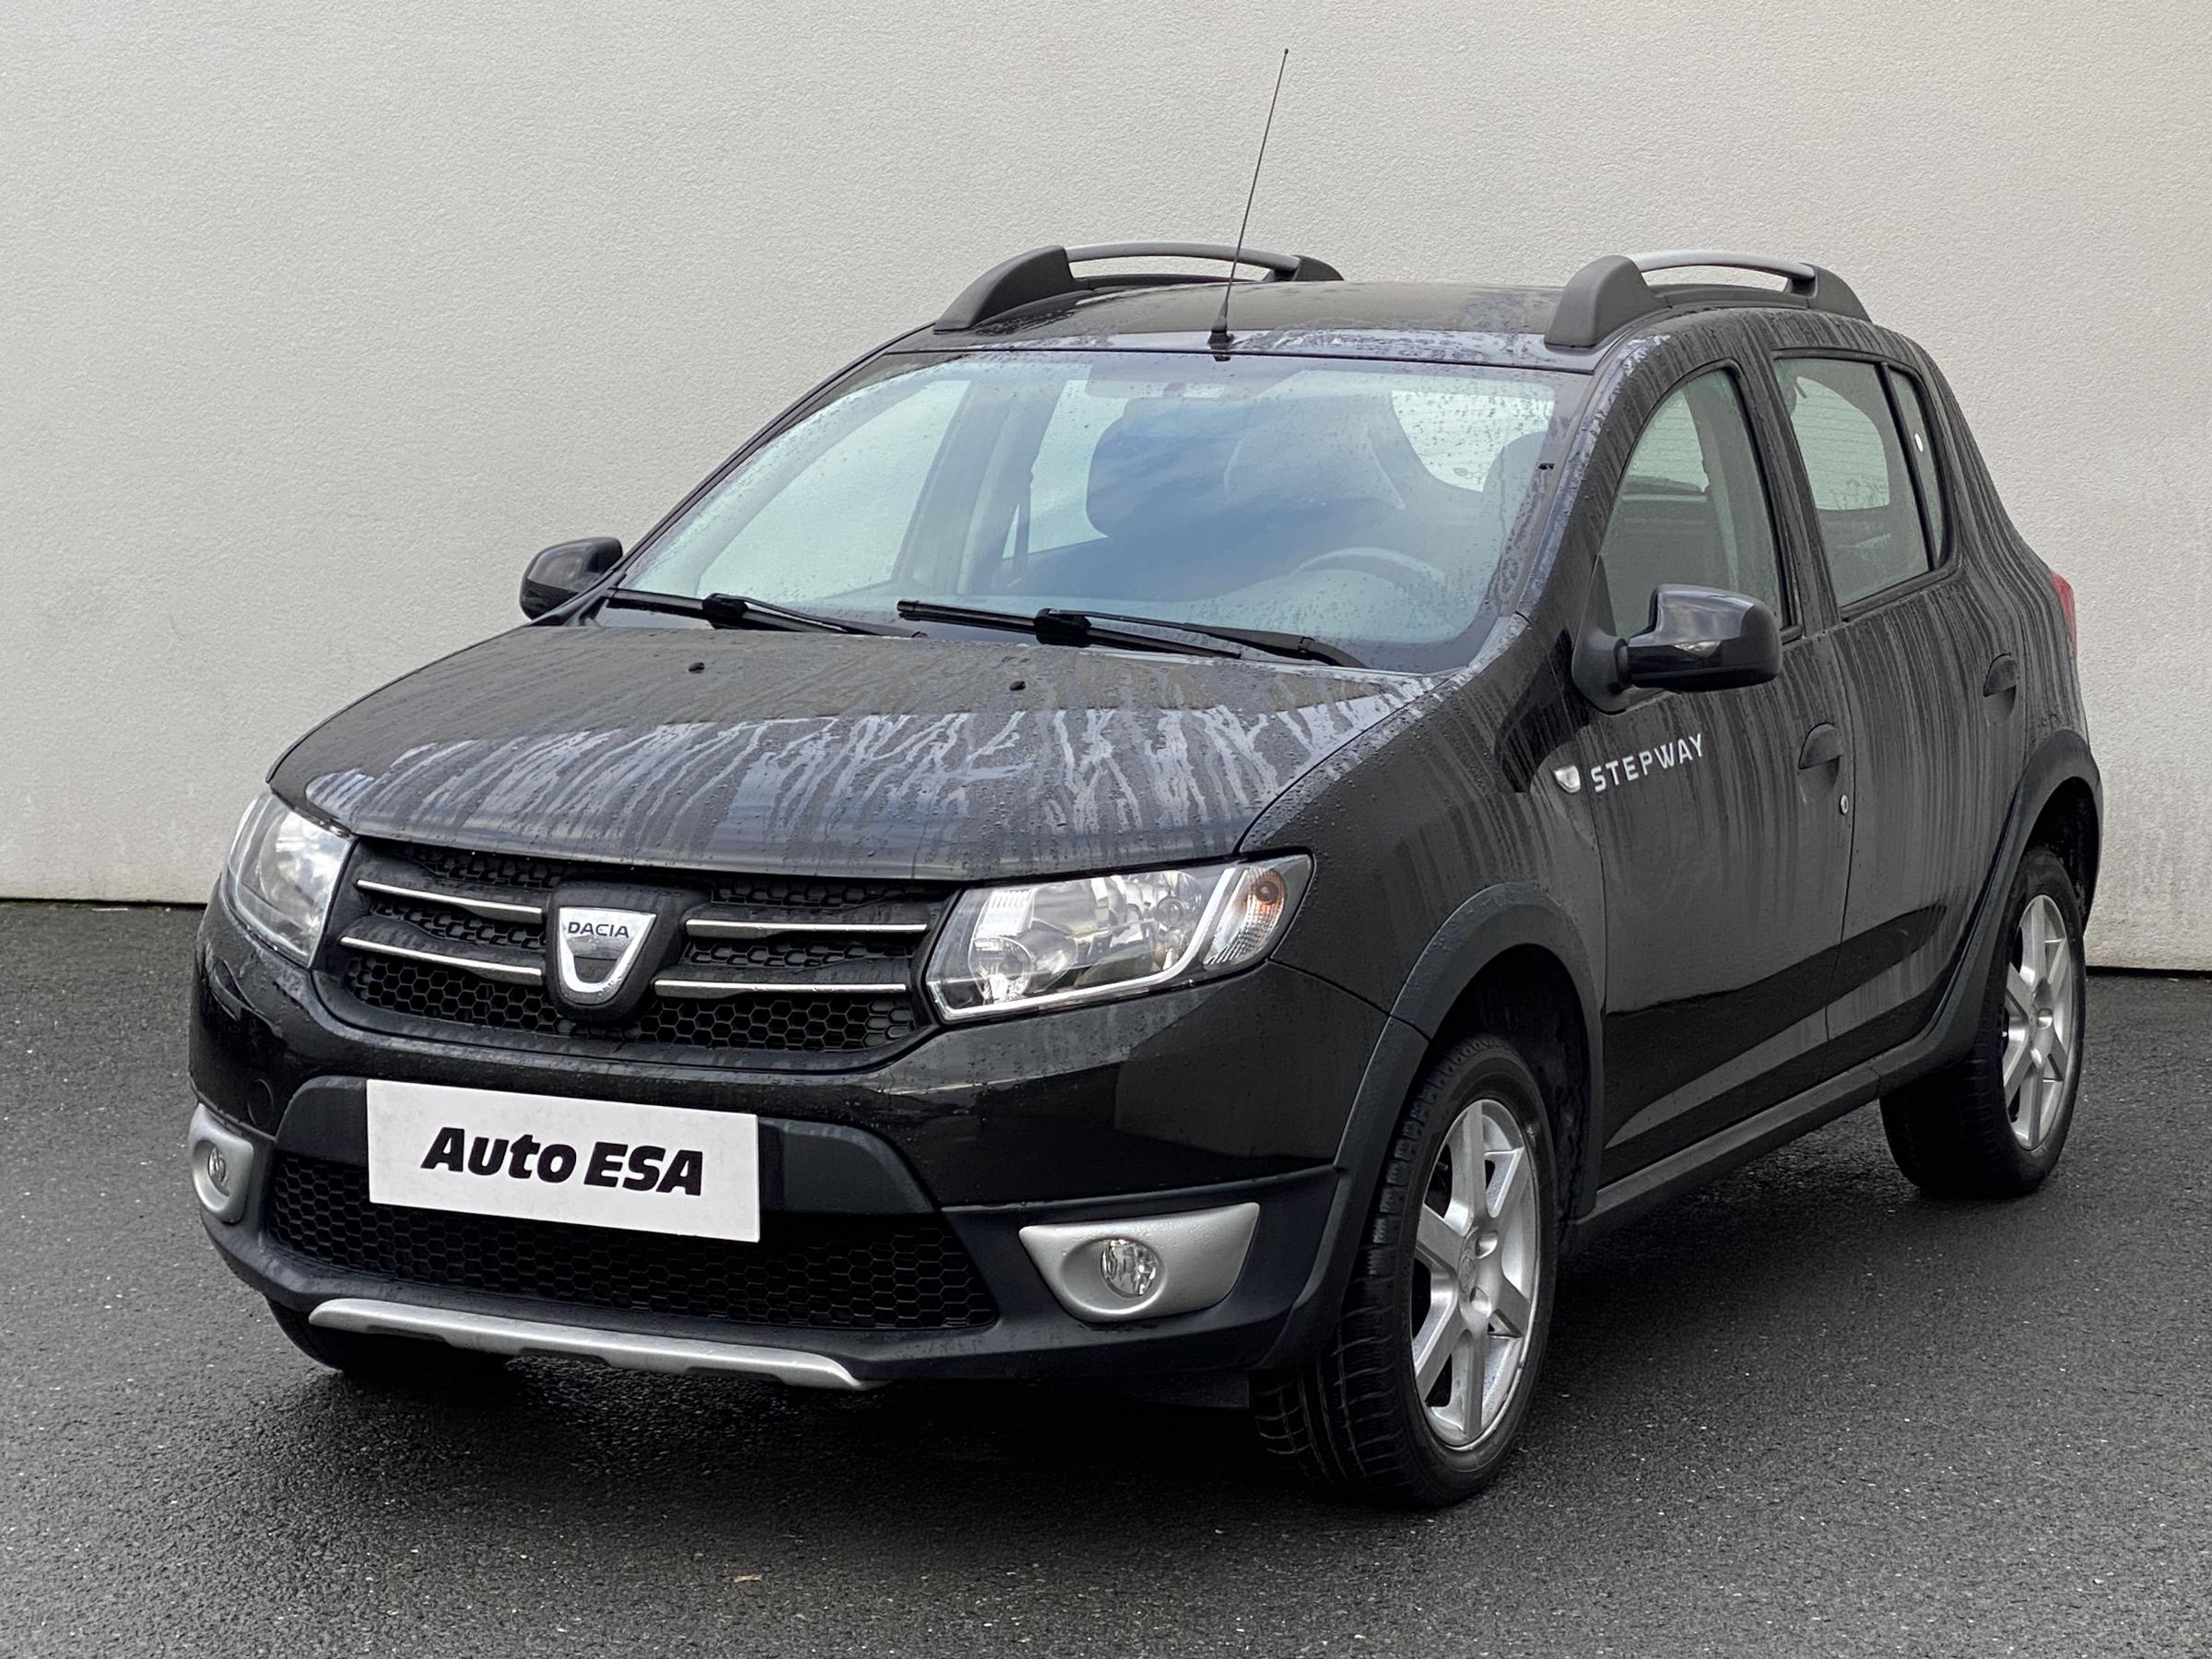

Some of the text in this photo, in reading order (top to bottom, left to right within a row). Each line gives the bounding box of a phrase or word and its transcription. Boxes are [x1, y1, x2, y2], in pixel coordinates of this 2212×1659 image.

[1590, 734, 1702, 793] STEPWAY
[567, 922, 629, 938] DACIA
[420, 1127, 703, 1196] Auto ESA
